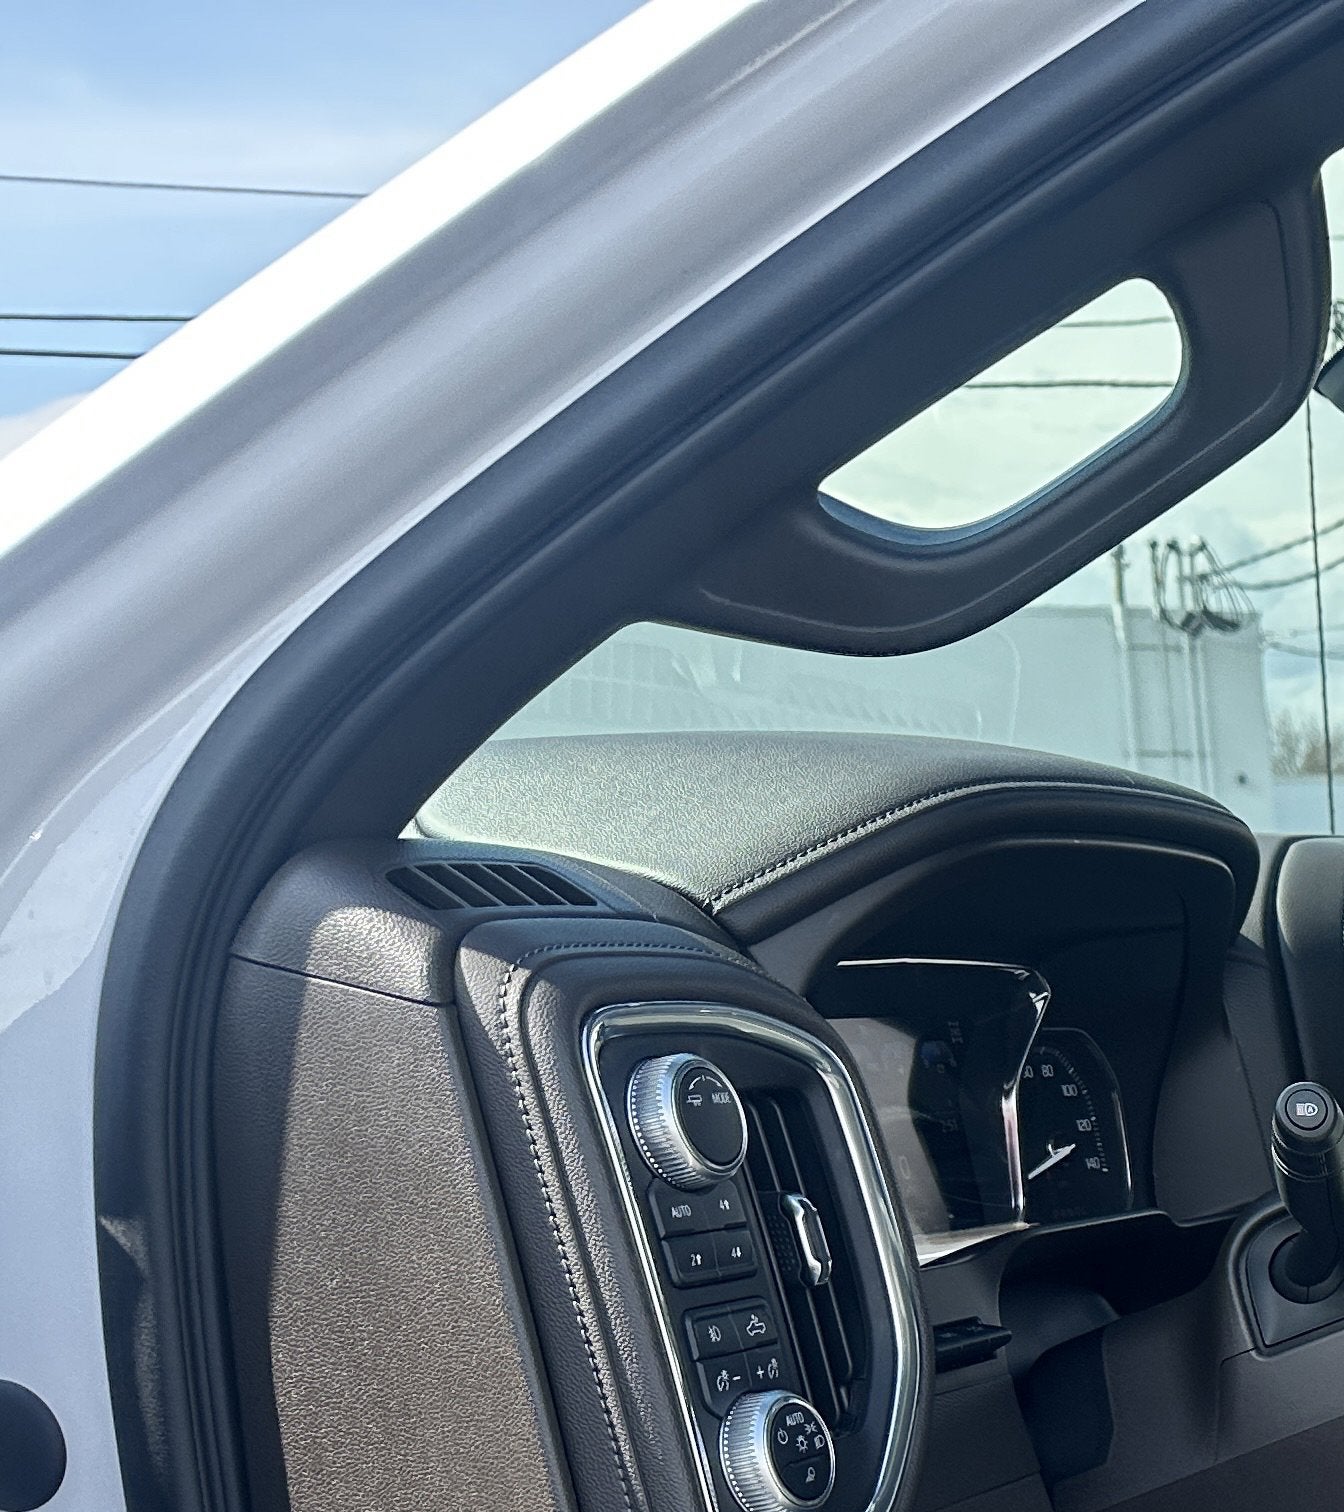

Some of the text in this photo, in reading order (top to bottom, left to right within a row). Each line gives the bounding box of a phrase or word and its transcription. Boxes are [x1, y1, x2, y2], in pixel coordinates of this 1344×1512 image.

[712, 1091, 731, 1104] MODE
[671, 1204, 692, 1218] AUTO
[785, 1411, 805, 1427] AUTO
